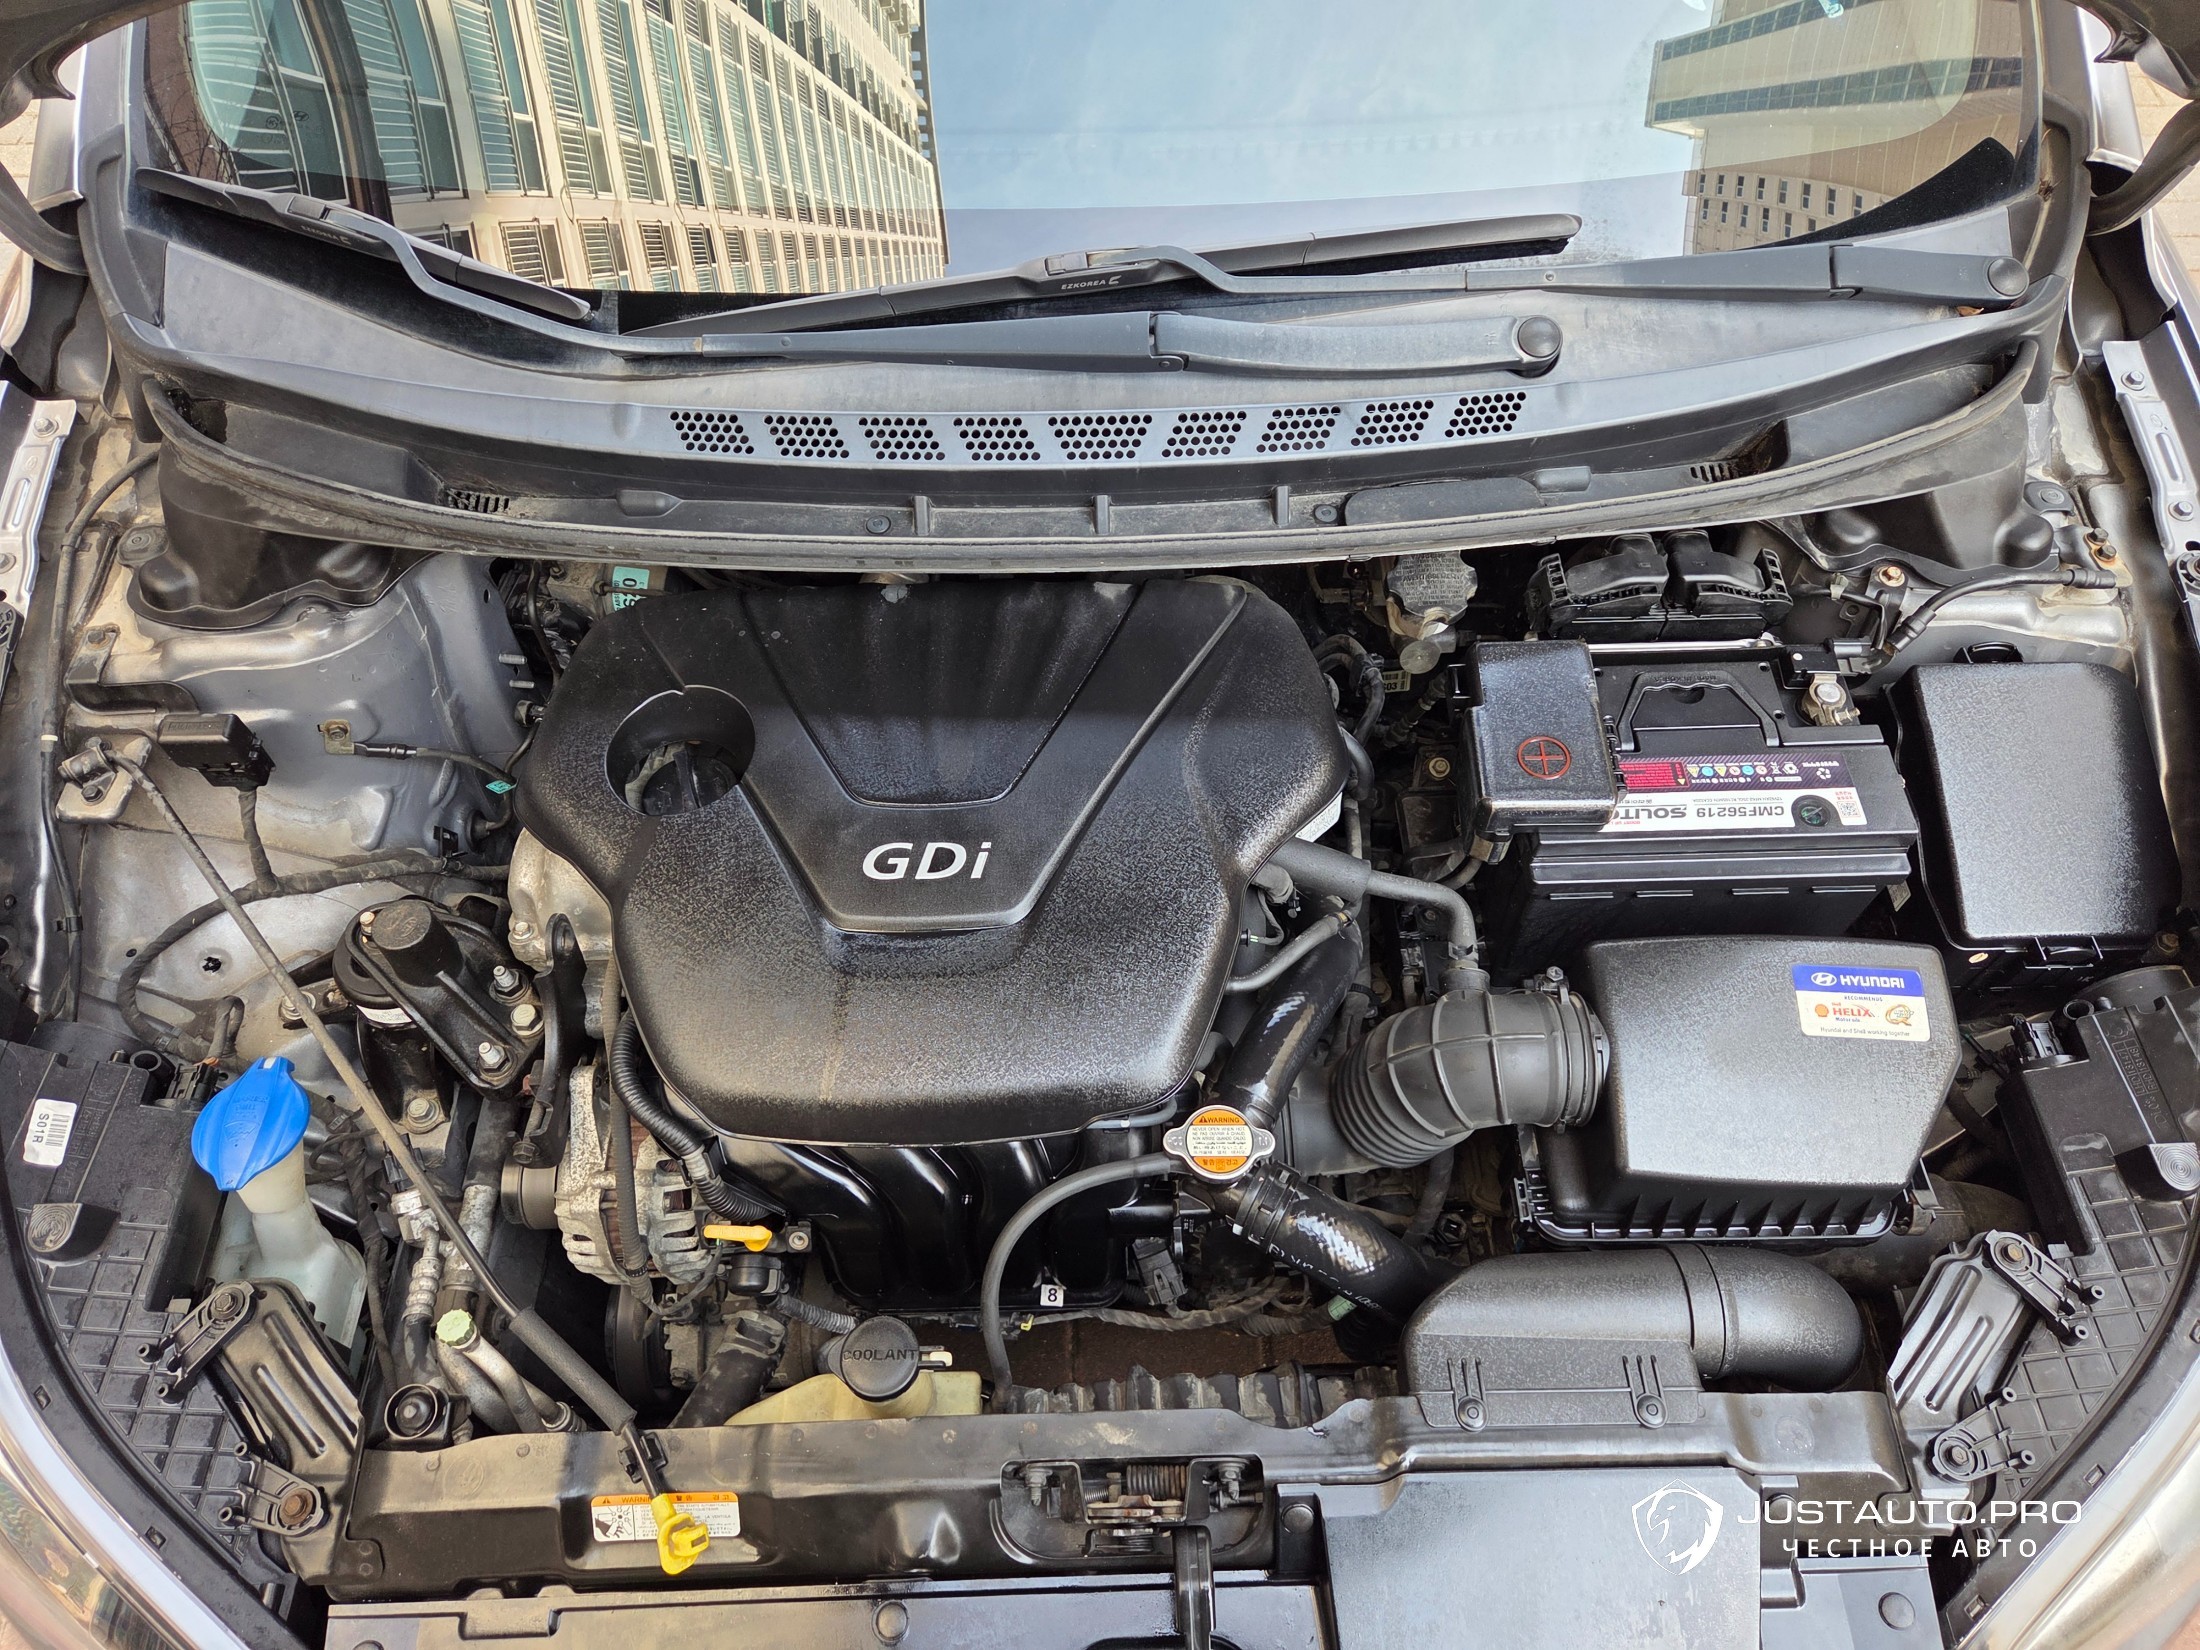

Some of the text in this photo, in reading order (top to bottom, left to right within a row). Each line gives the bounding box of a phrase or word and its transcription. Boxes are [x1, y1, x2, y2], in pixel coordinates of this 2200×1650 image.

[1061, 279, 1106, 290] EZKOREA
[1696, 805, 1785, 818] CMF56219
[862, 841, 992, 880] GDi
[1839, 974, 1905, 989] HYUNDAI
[1833, 1007, 1873, 1018] HELIX
[32, 1113, 50, 1143] S01R
[1047, 1287, 1057, 1302] 8
[842, 1349, 918, 1361] COOLANT
[621, 1496, 652, 1504] WARNI
